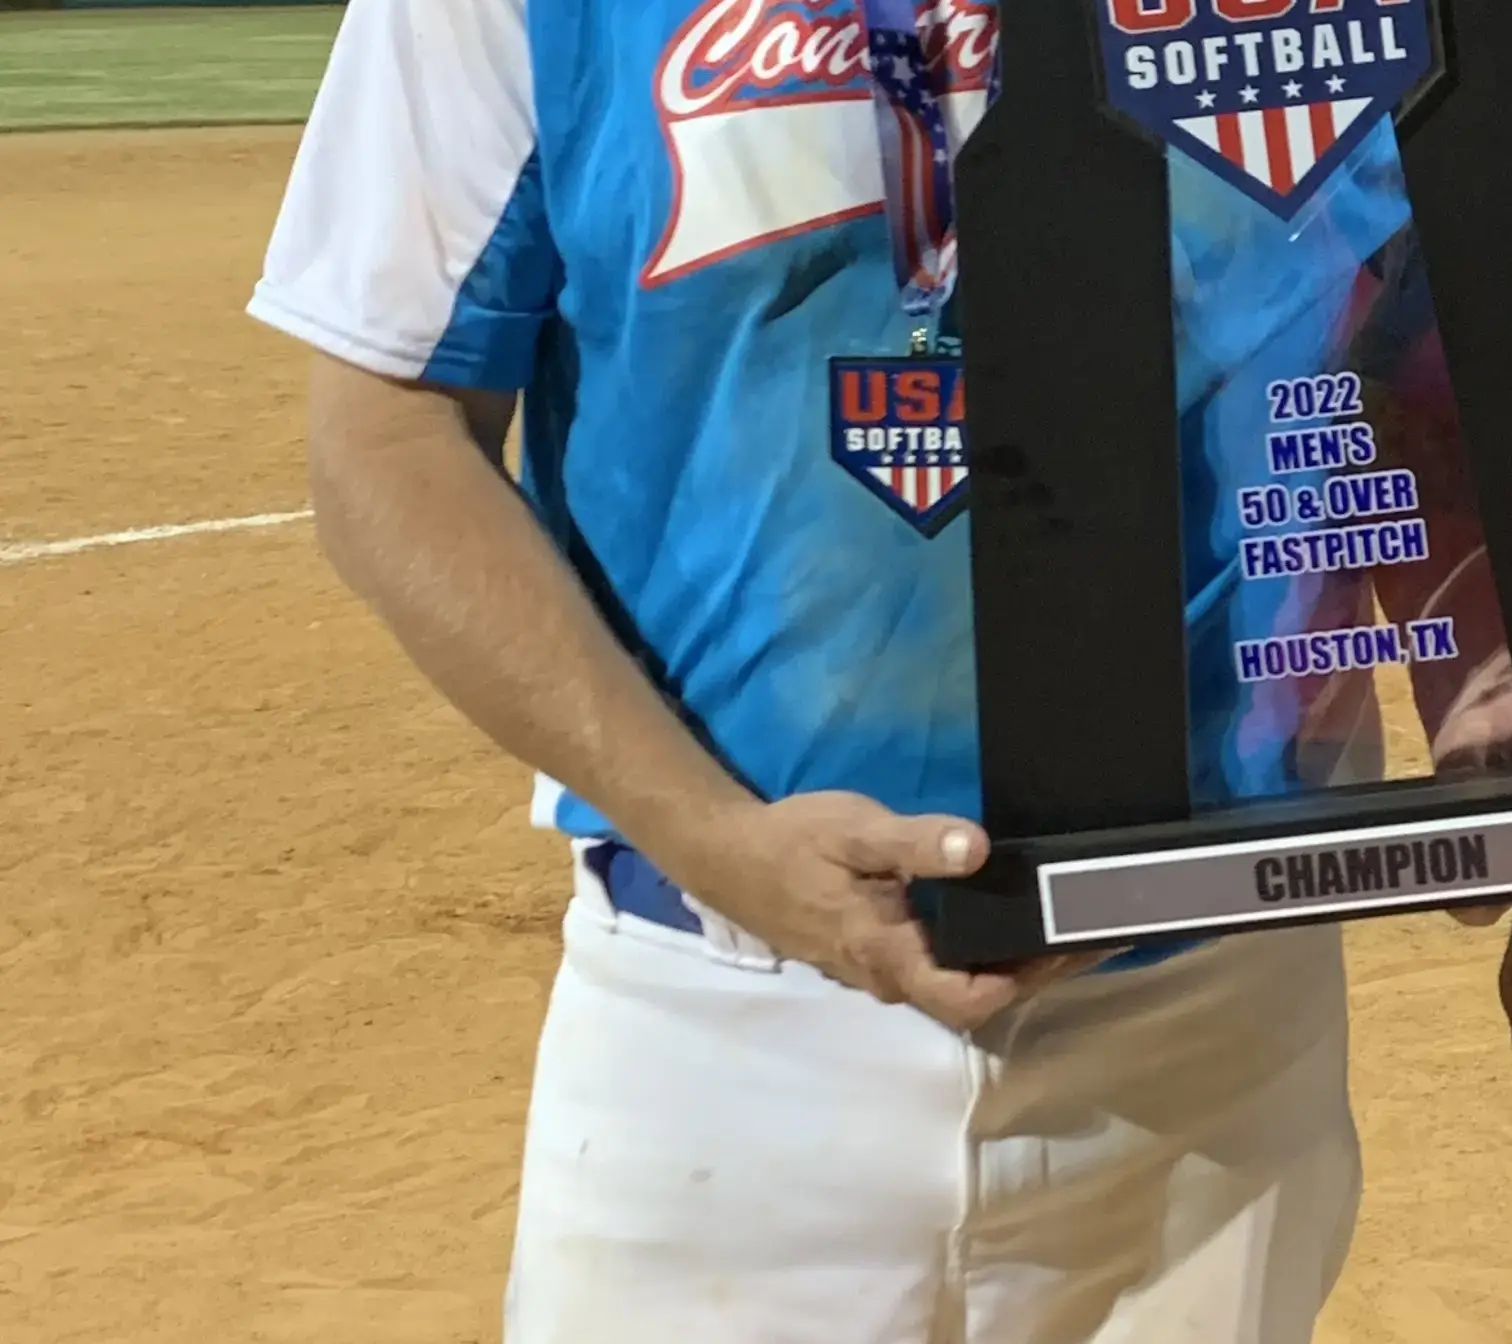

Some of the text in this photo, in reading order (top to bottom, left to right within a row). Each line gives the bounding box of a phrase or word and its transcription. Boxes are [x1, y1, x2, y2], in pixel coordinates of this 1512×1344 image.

[1123, 16, 1408, 91] SOFTBALL
[1267, 372, 1363, 423] 2022
[845, 426, 964, 453] SOFTBA
[1266, 423, 1377, 475] MEN'S
[1238, 469, 1419, 529] 50 & OVER
[1239, 519, 1429, 580] FASTPITCH
[1235, 616, 1459, 683] HOUSTON, TX
[1254, 833, 1490, 904] CHAMPION
